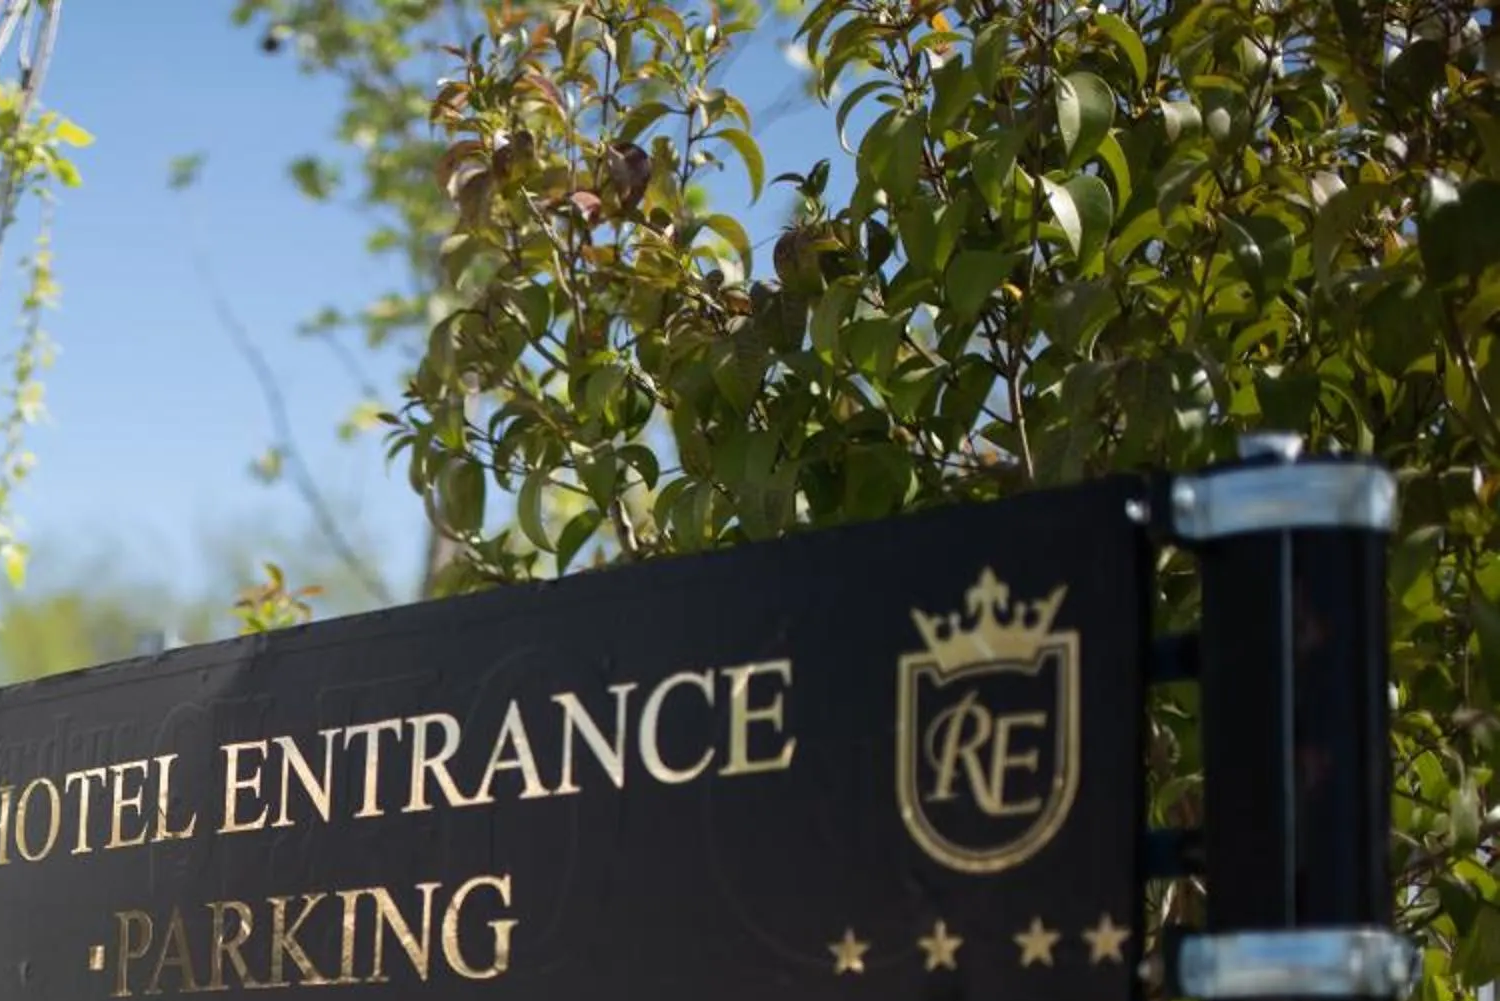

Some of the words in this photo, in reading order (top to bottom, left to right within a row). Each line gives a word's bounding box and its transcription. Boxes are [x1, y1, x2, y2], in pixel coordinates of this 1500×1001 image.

[216, 657, 796, 836] ENTRANCE
[924, 690, 1048, 818] RE
[109, 872, 518, 997] PARKING
